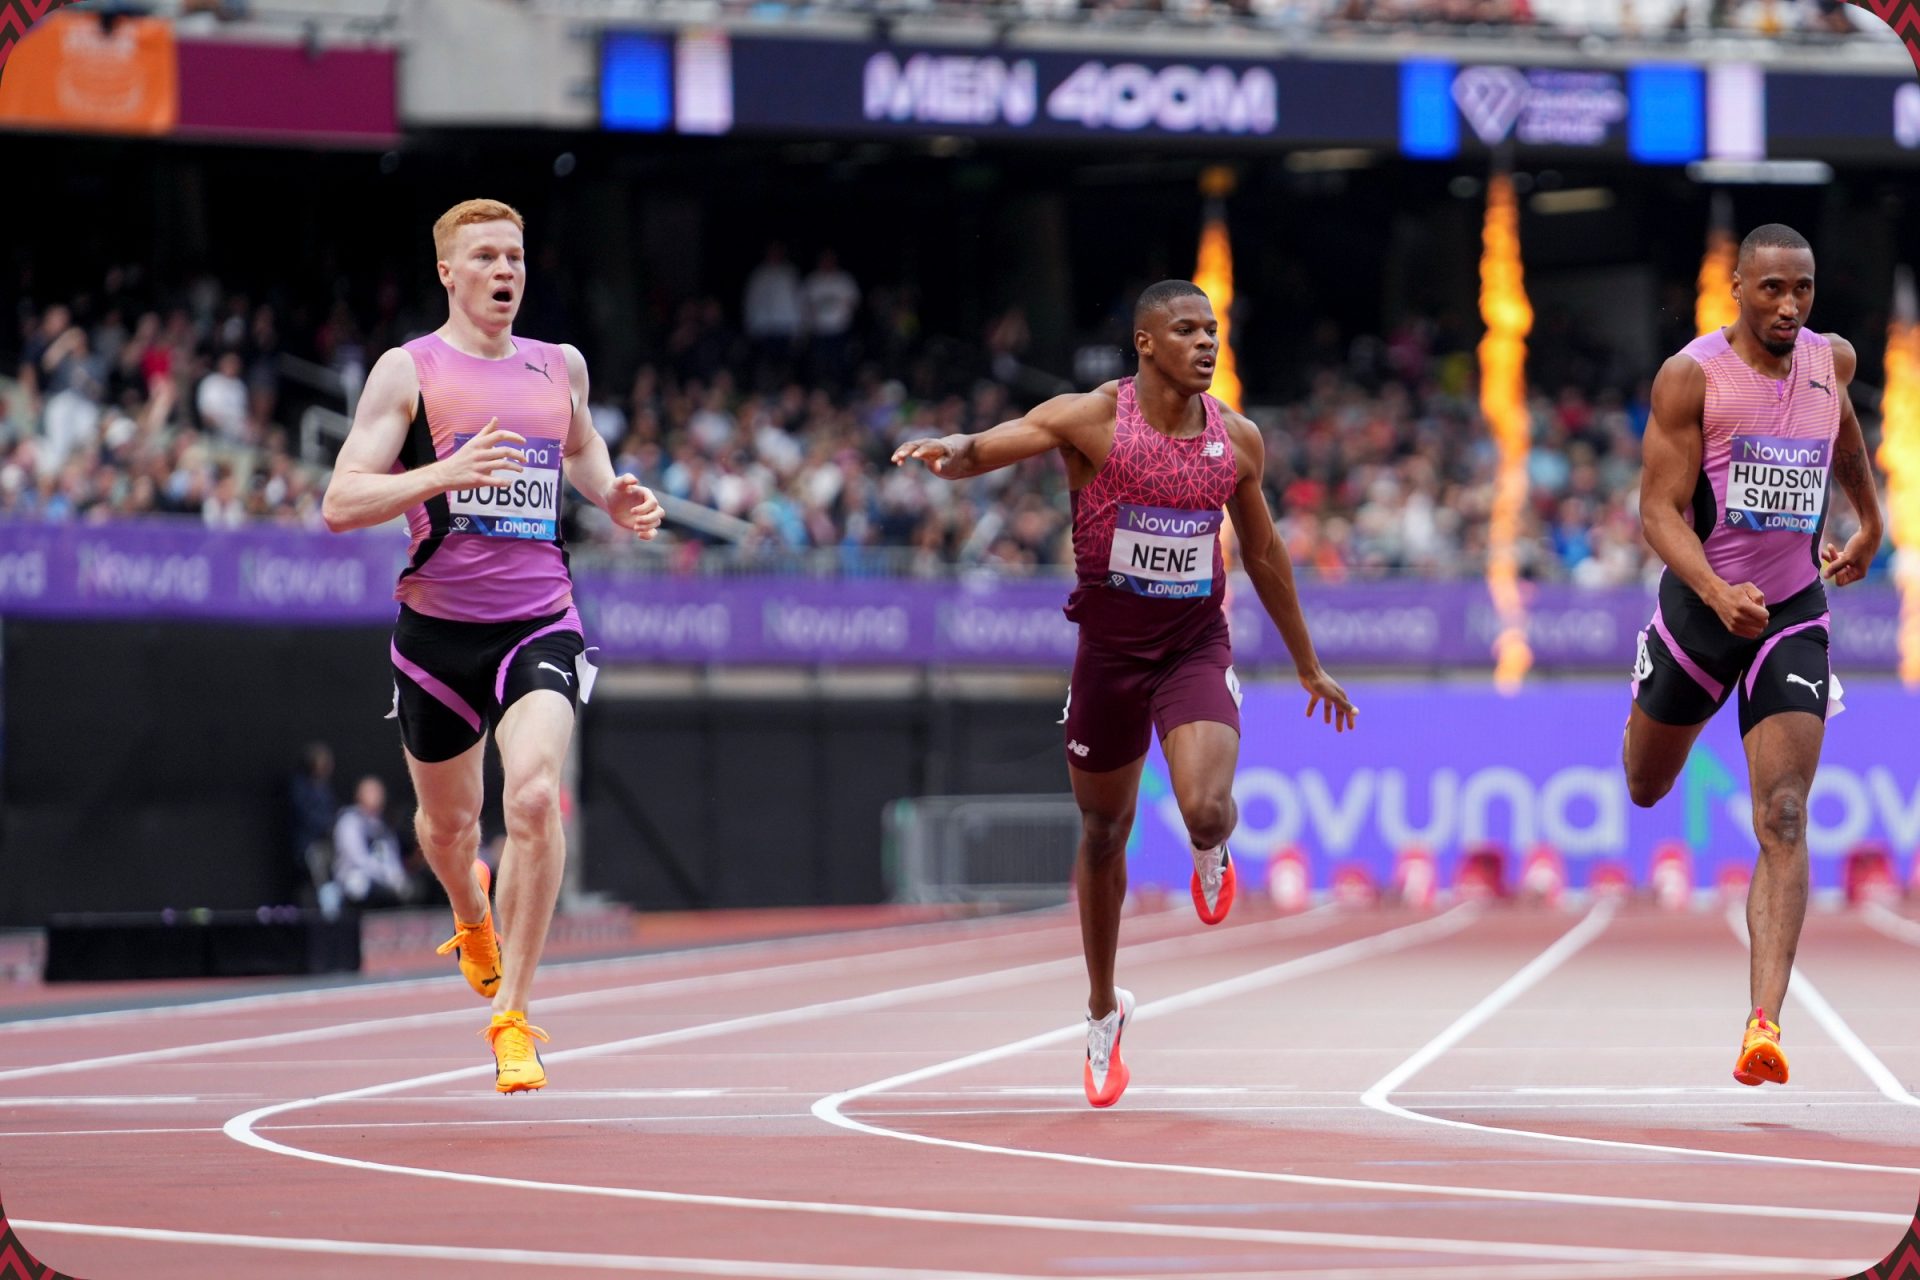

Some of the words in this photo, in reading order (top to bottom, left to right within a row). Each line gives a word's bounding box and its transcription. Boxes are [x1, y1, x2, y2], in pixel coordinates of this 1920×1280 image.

[863, 52, 1037, 125] MEN
[1047, 61, 1278, 133] 400M
[1743, 441, 1821, 463] Novuna
[1733, 464, 1822, 489] HUDSON
[456, 479, 553, 510] DOBSON
[1743, 488, 1814, 512] SMITH
[495, 520, 546, 534] LONDON
[1128, 510, 1210, 534] Novuna
[1765, 516, 1817, 530] LONDON
[1131, 543, 1198, 573] NENE
[1147, 583, 1199, 596] LONDON
